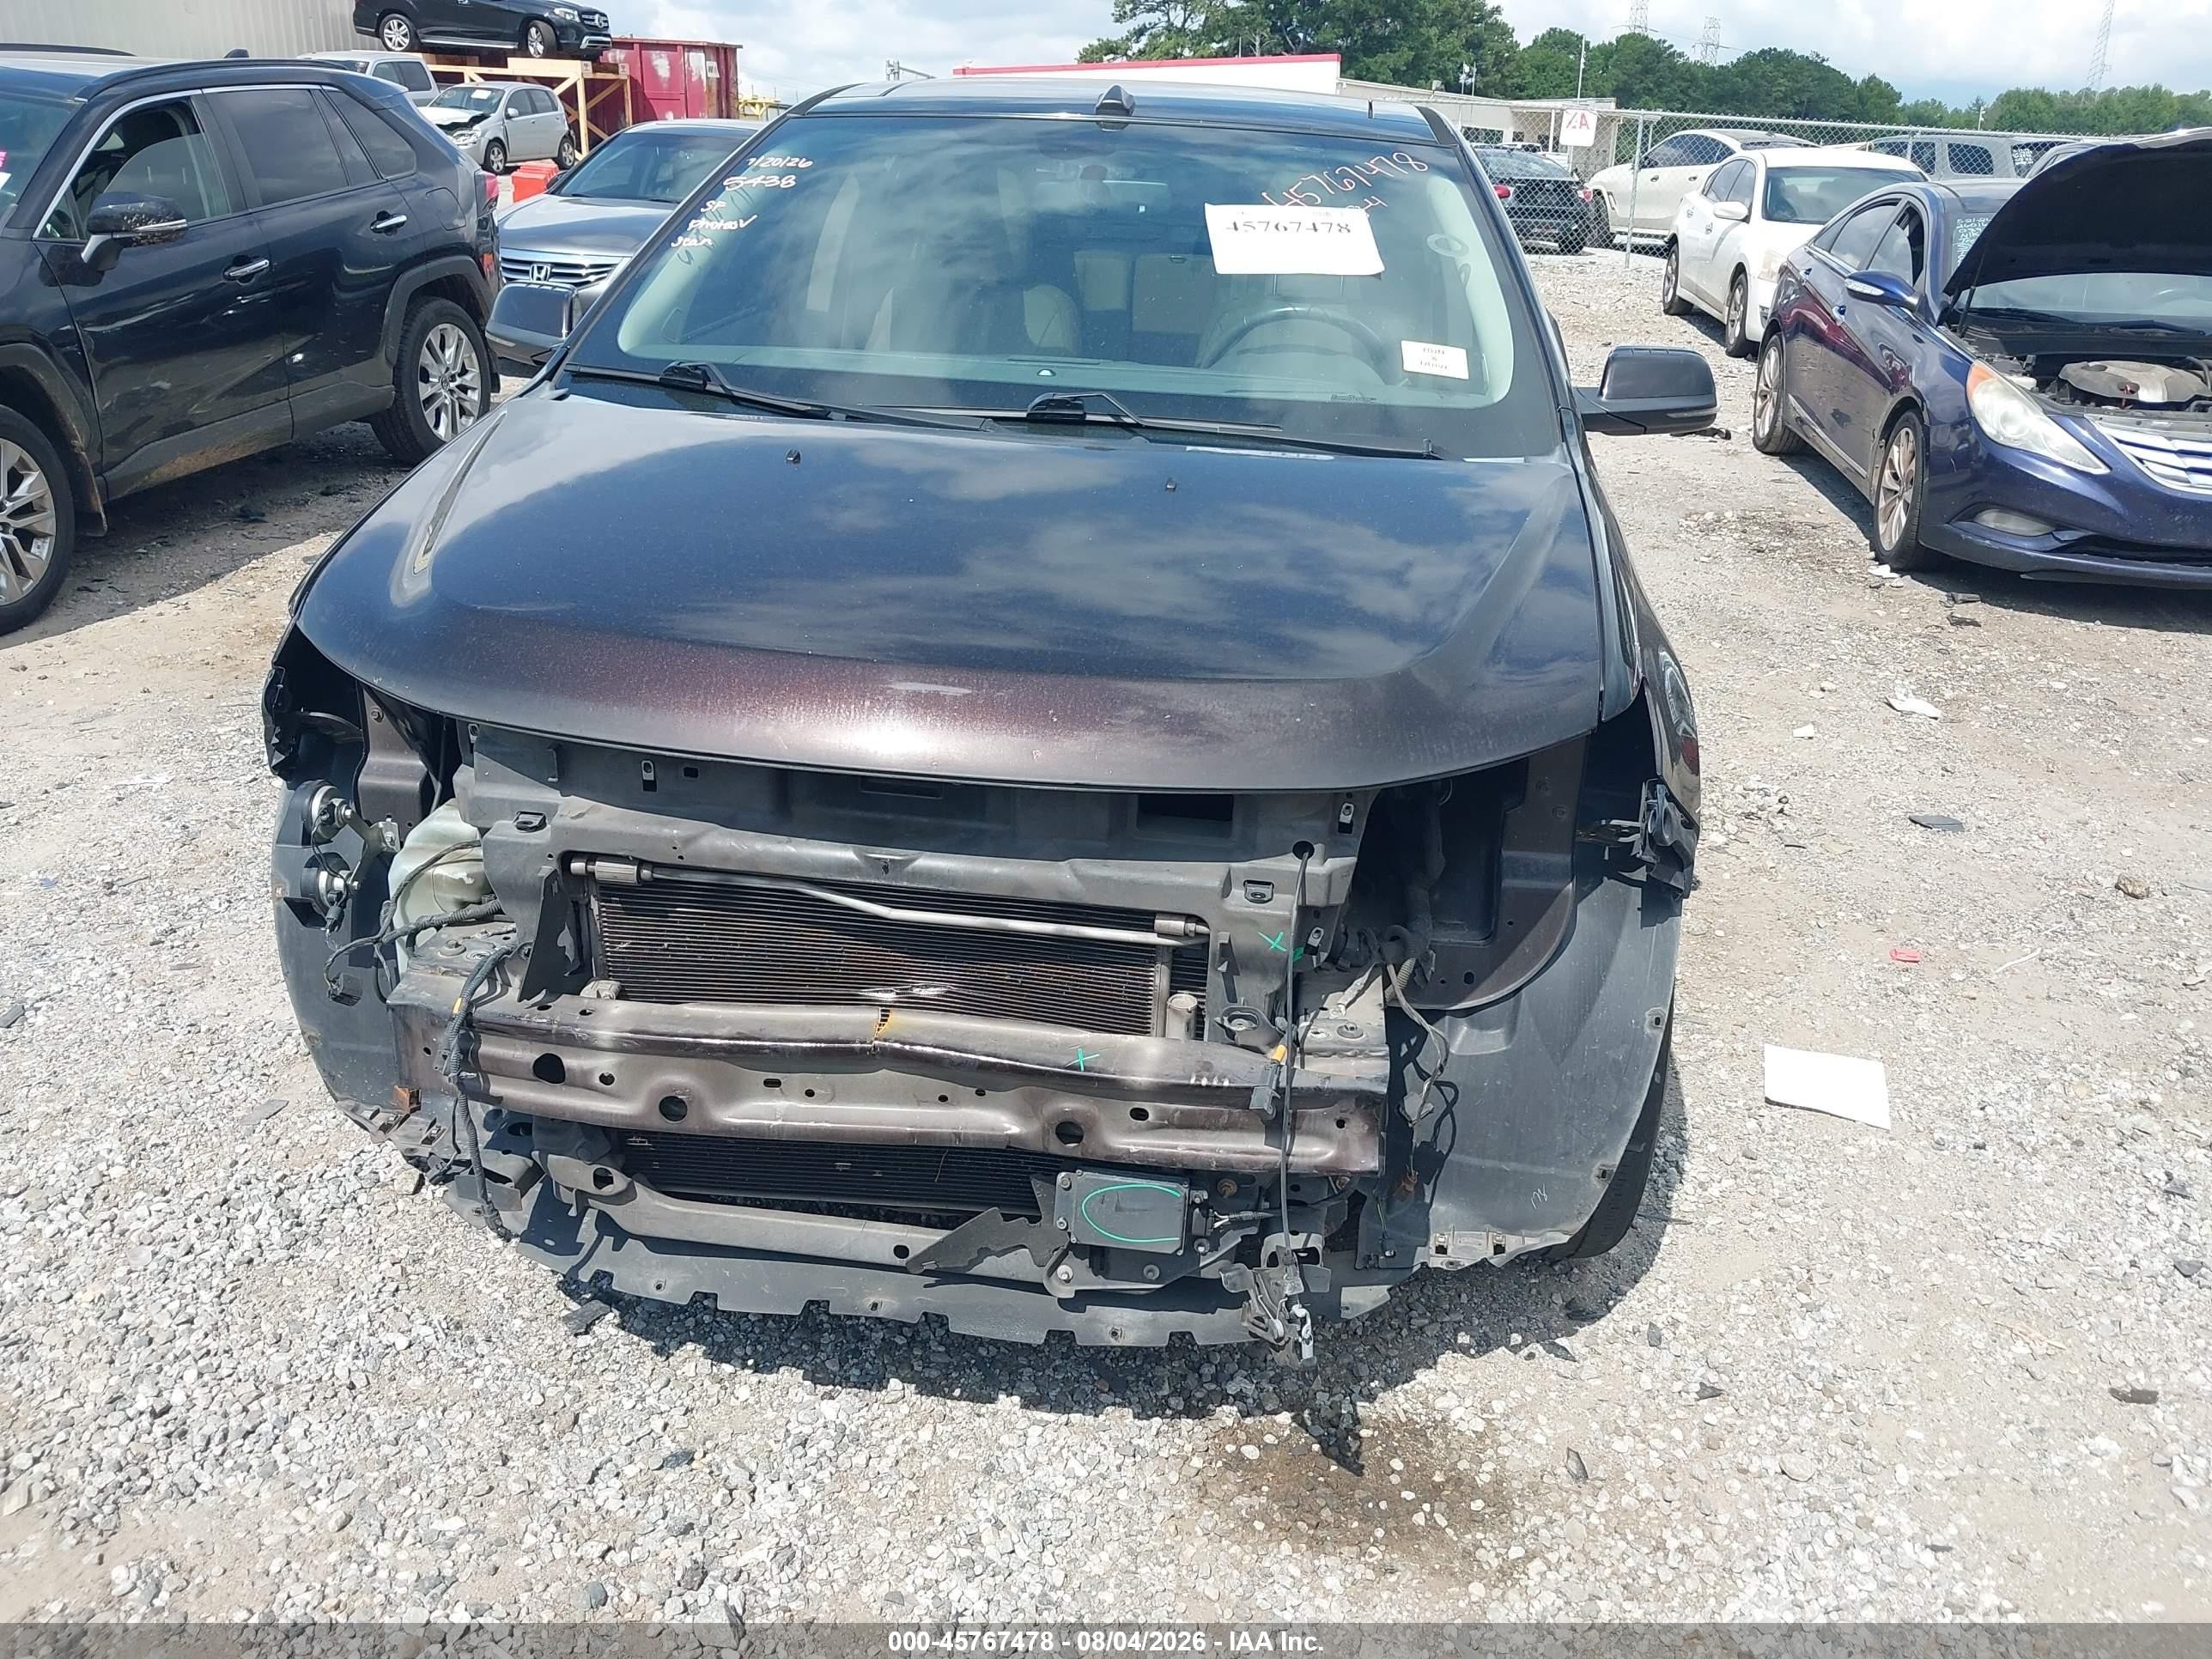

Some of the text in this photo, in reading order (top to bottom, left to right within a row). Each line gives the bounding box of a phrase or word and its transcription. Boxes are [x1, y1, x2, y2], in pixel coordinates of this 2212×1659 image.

[747, 155, 813, 167] 7/20/26
[723, 174, 797, 191] 5438
[1261, 152, 1429, 206] 45767478
[1226, 220, 1352, 234] 45767478
